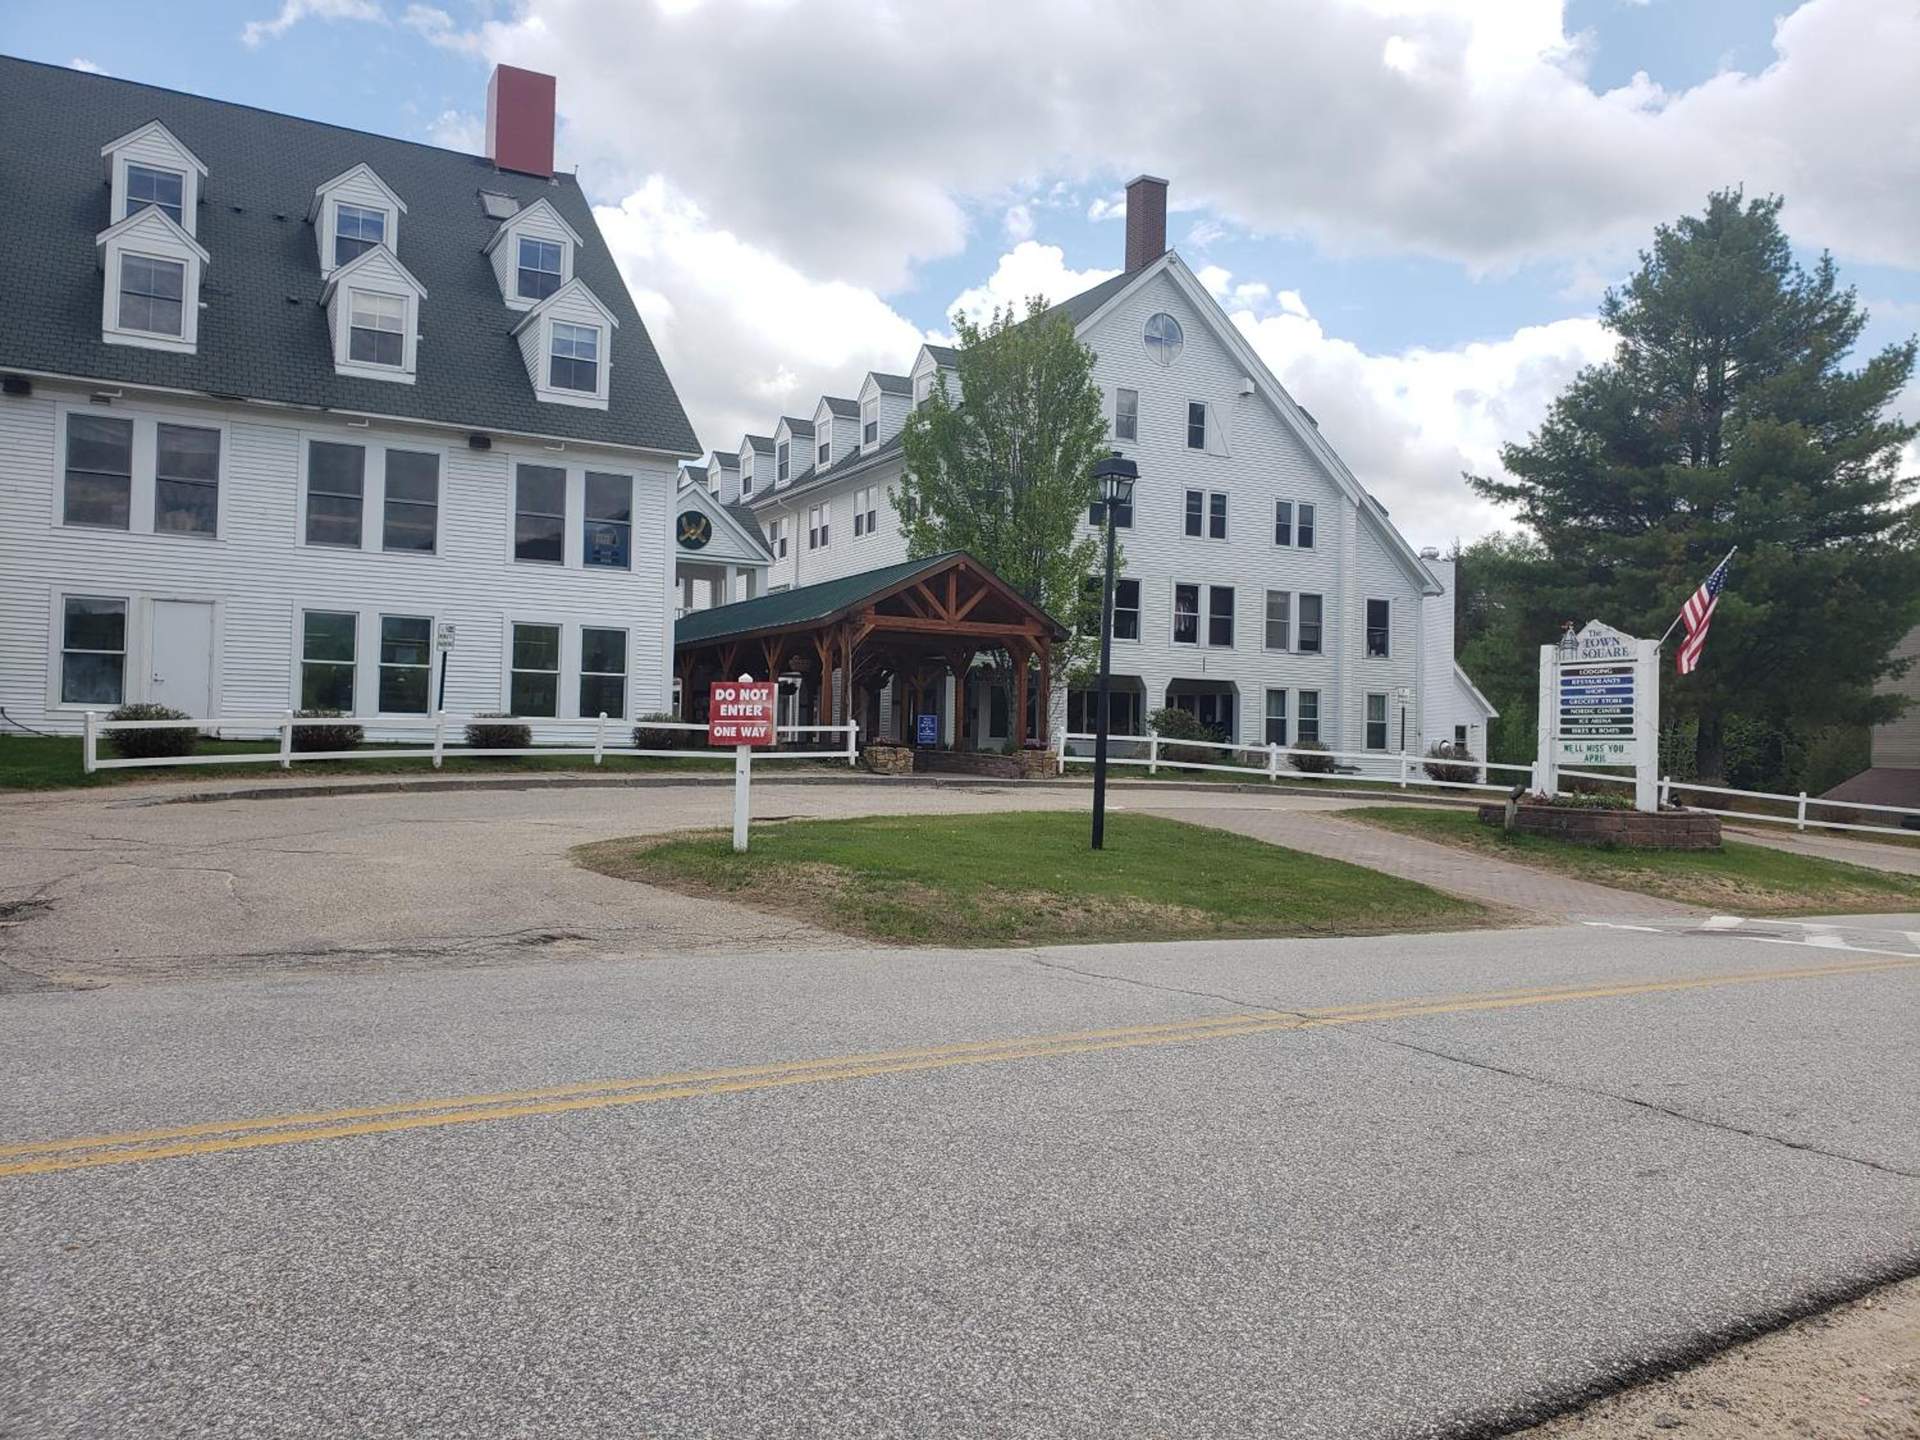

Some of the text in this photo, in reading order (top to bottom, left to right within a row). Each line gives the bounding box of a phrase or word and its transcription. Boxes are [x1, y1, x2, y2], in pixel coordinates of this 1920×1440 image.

[1585, 637, 1620, 648] TOWN
[1582, 647, 1629, 658] SQUARE
[715, 688, 769, 701] DO NOT
[720, 704, 763, 716] ENTER
[714, 726, 767, 737] ONE WAY
[1586, 744, 1605, 752] MISS
[1608, 744, 1624, 752] YOU
[1584, 754, 1606, 763] APRIL
